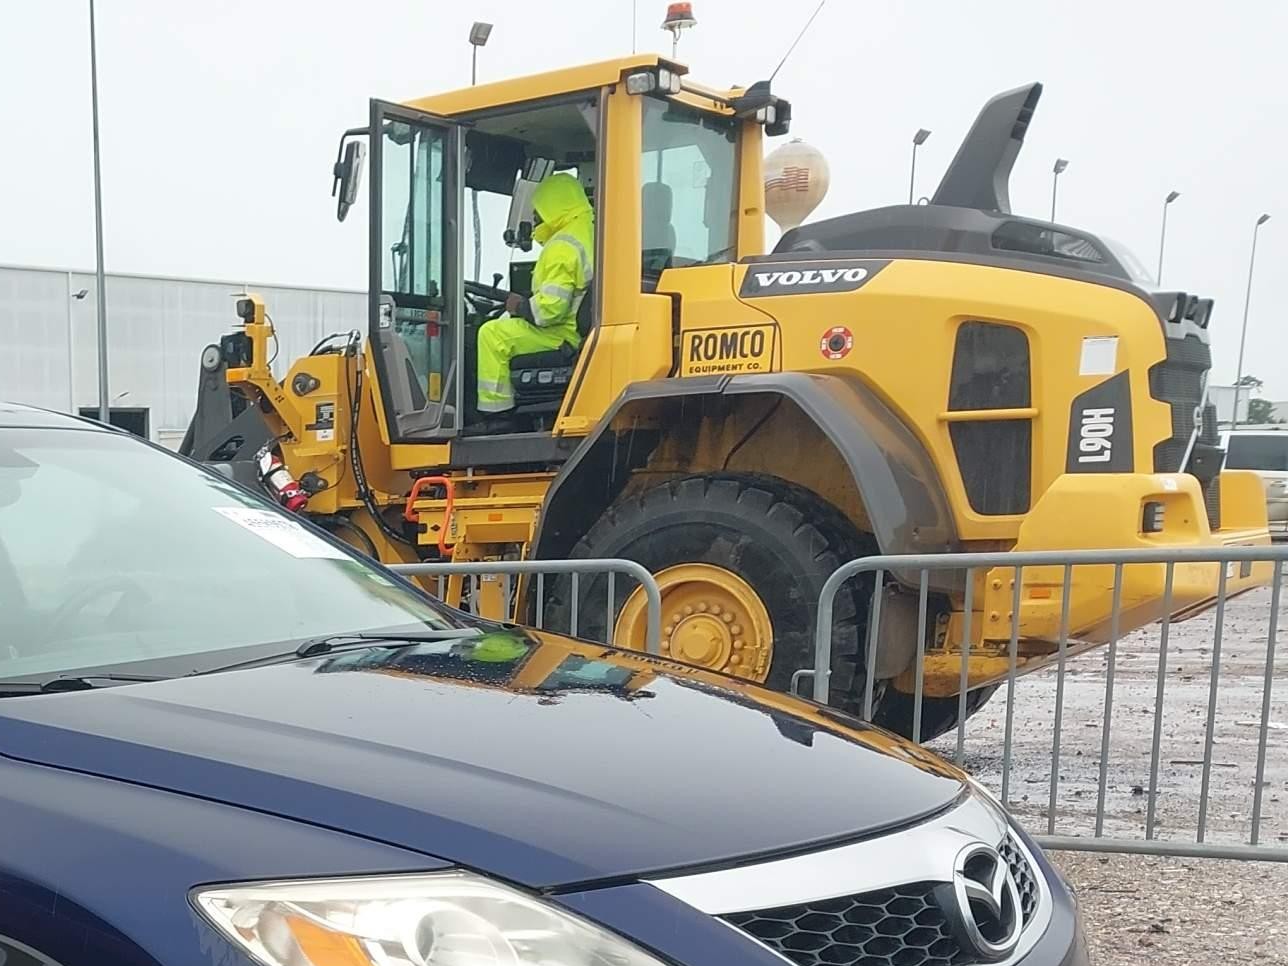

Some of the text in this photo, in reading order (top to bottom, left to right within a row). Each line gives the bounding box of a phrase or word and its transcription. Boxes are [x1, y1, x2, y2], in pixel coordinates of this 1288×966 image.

[754, 267, 868, 288] VOLVO
[689, 329, 765, 362] ROMCO
[689, 362, 763, 374] EQUIPMENT CO.
[1078, 407, 1115, 463] L90H
